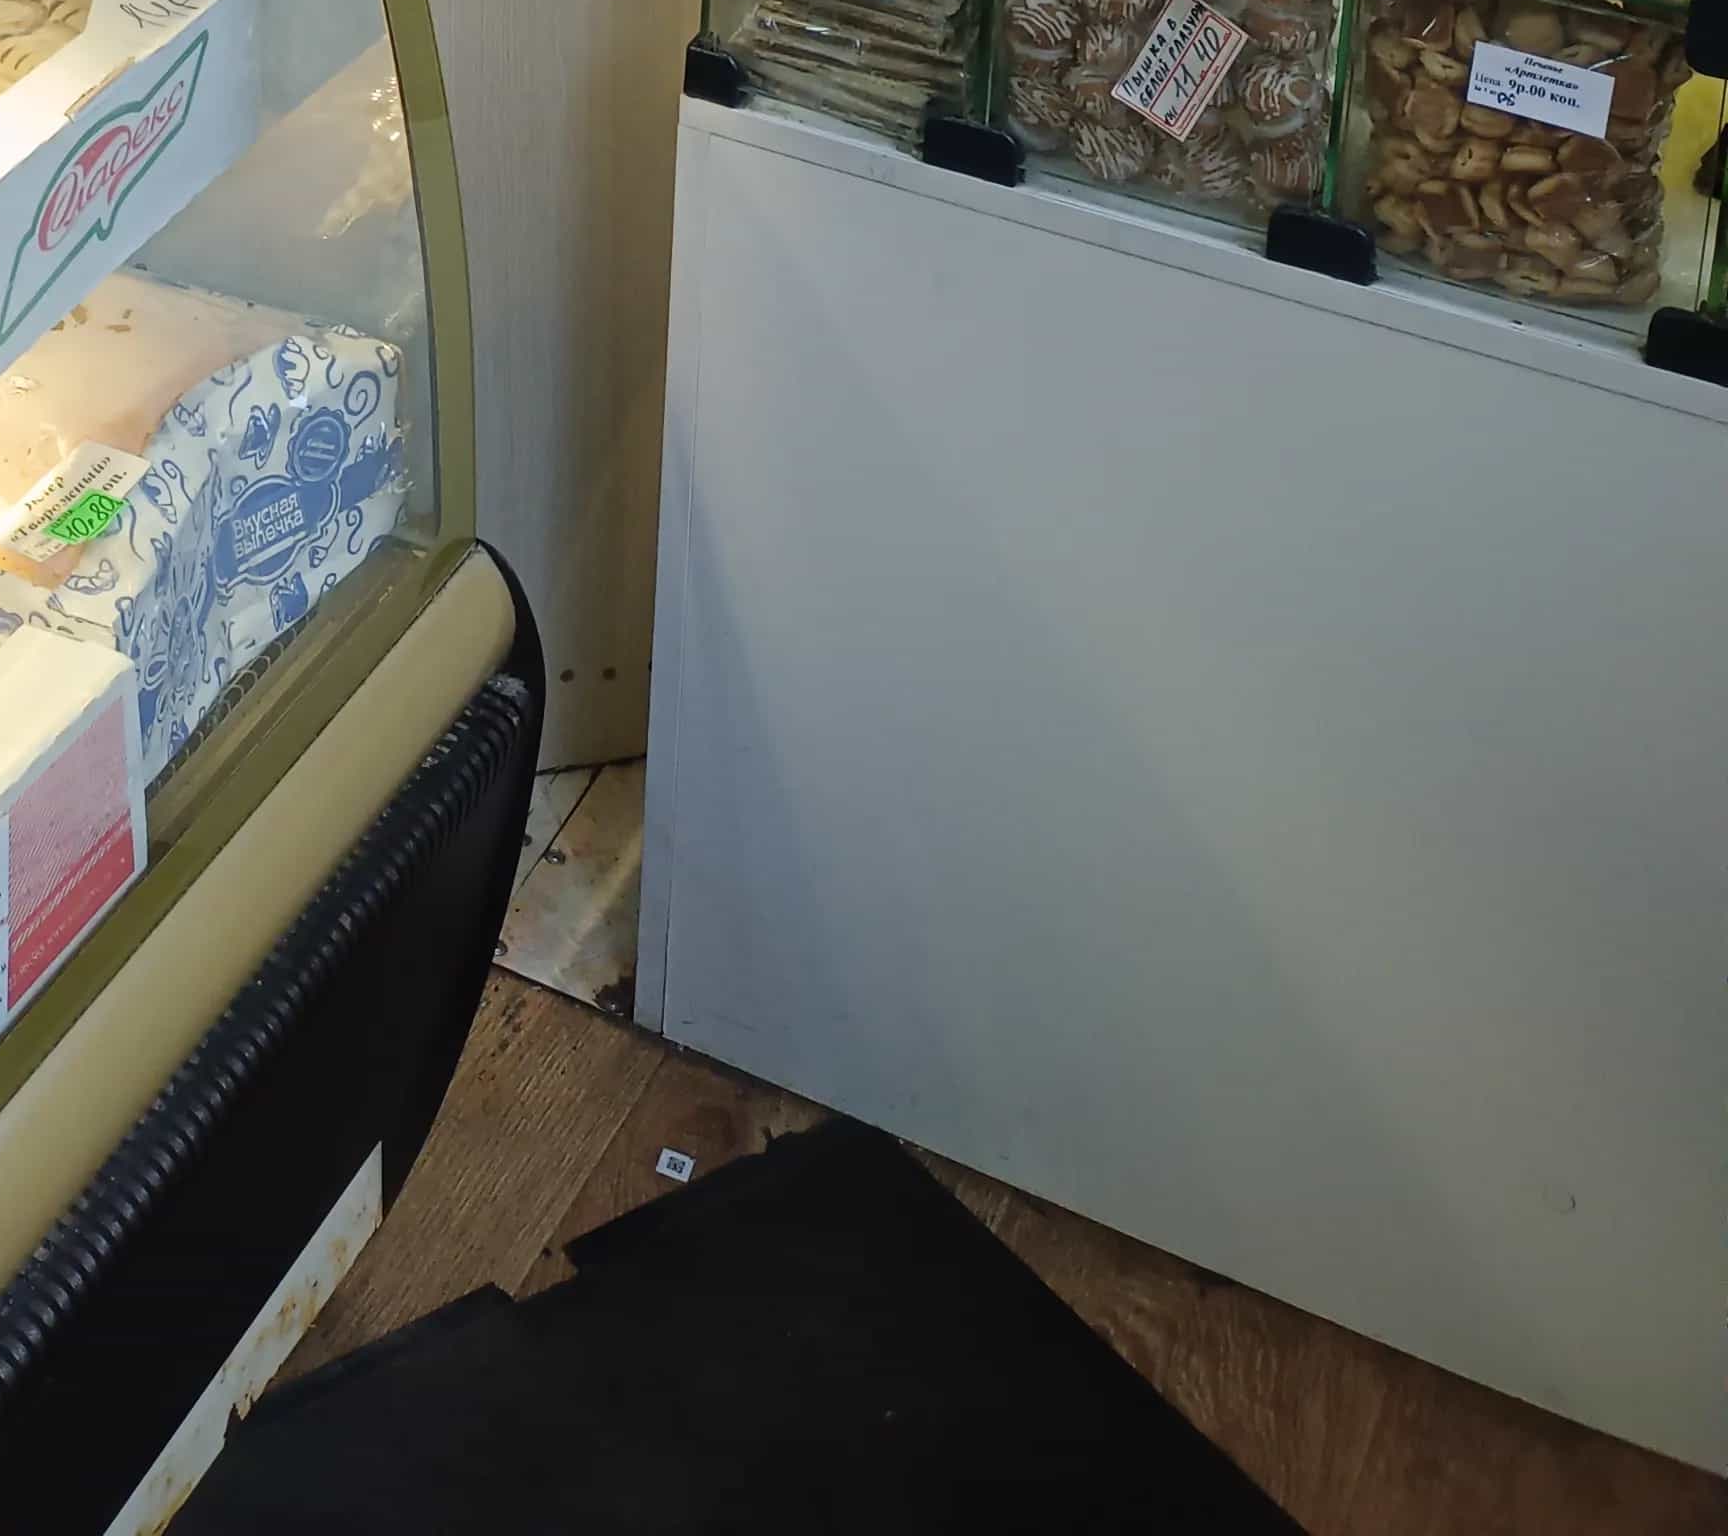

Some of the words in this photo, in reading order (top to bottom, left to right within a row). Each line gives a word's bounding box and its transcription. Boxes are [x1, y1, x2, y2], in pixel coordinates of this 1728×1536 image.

[1122, 34, 1167, 97] ПЫШКА
[1139, 57, 1171, 108] БЕЛОЙ
[1508, 79, 1547, 98] 9р.00
[1550, 92, 1581, 109] коп.
